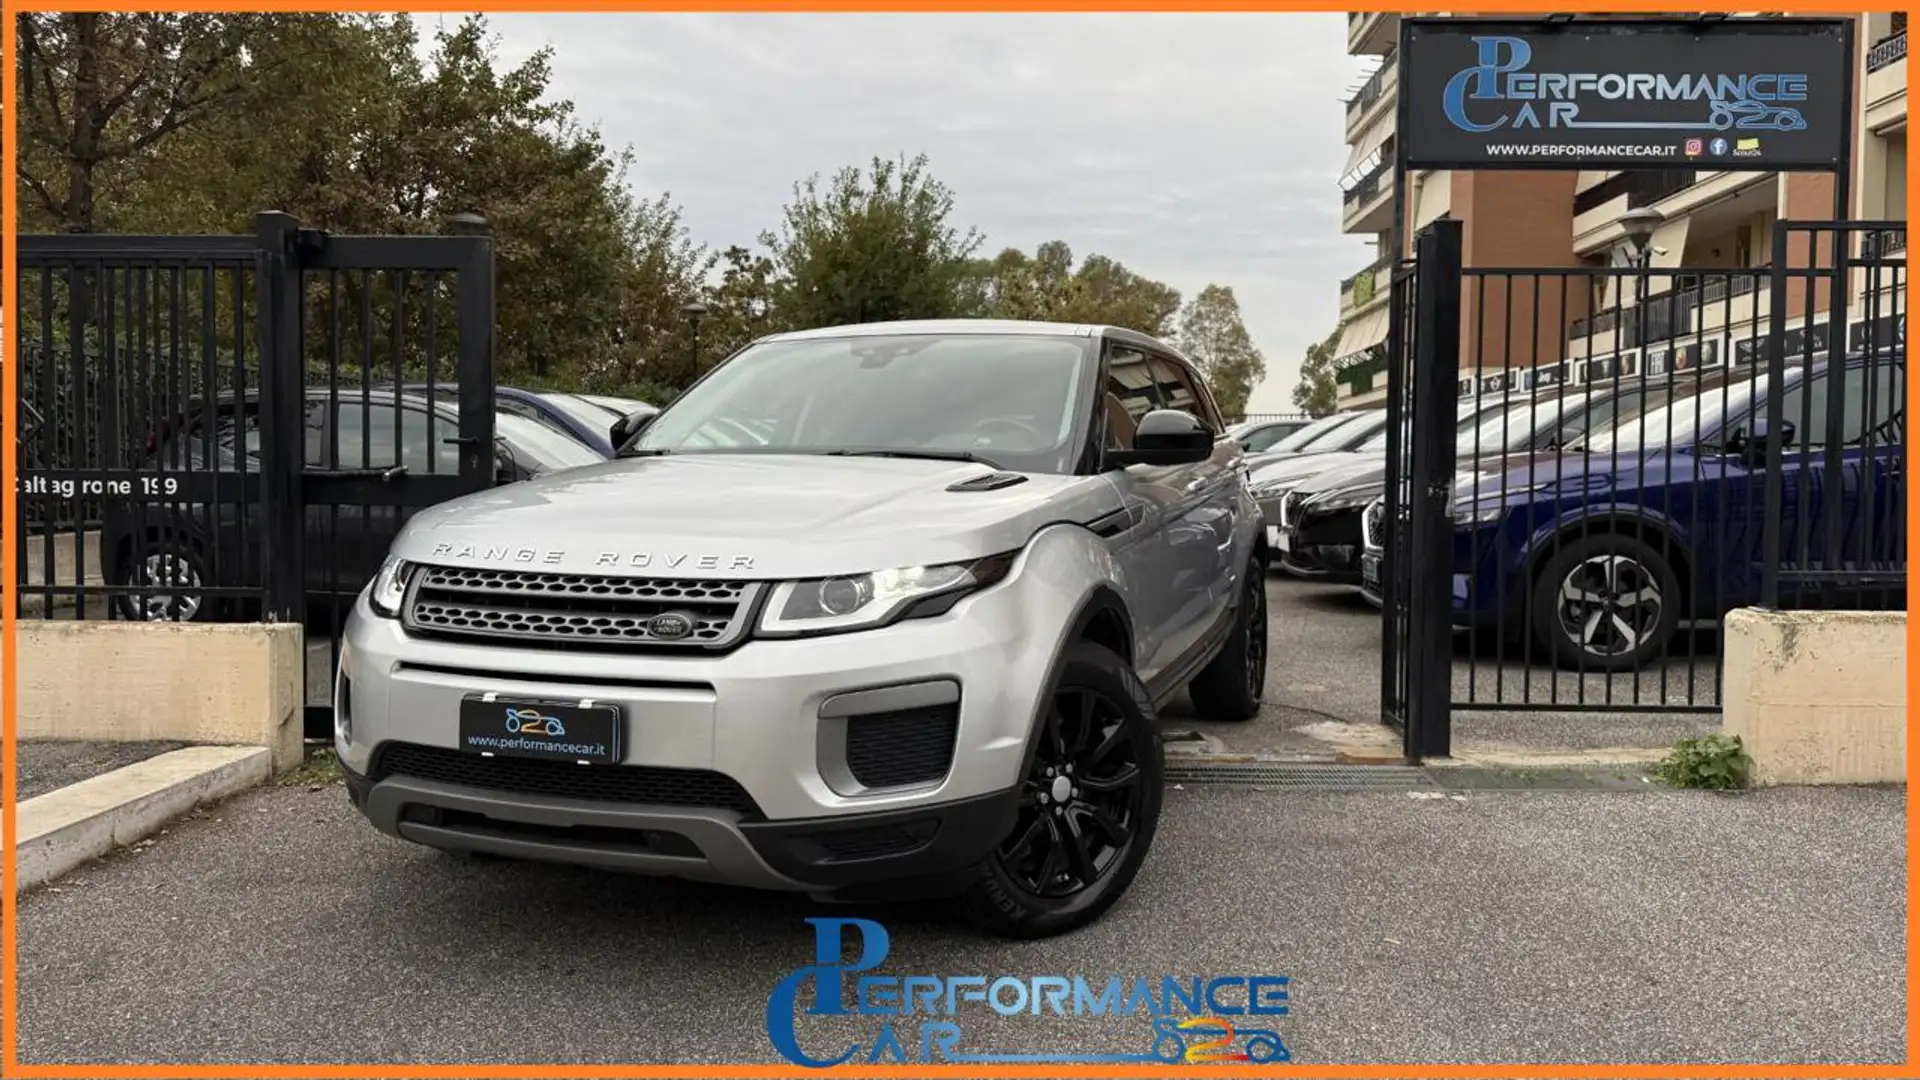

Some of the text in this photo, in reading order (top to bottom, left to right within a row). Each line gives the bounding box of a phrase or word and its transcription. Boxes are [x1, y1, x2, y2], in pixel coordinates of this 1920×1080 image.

[1471, 36, 1808, 101] PERFORMANCE
[1486, 143, 1677, 158] WWW.PERFORMANCECAR.IT
[15, 474, 178, 498] altagrone 199
[432, 543, 757, 571] RANGE ROVER
[468, 735, 606, 756] www.performancecar.it
